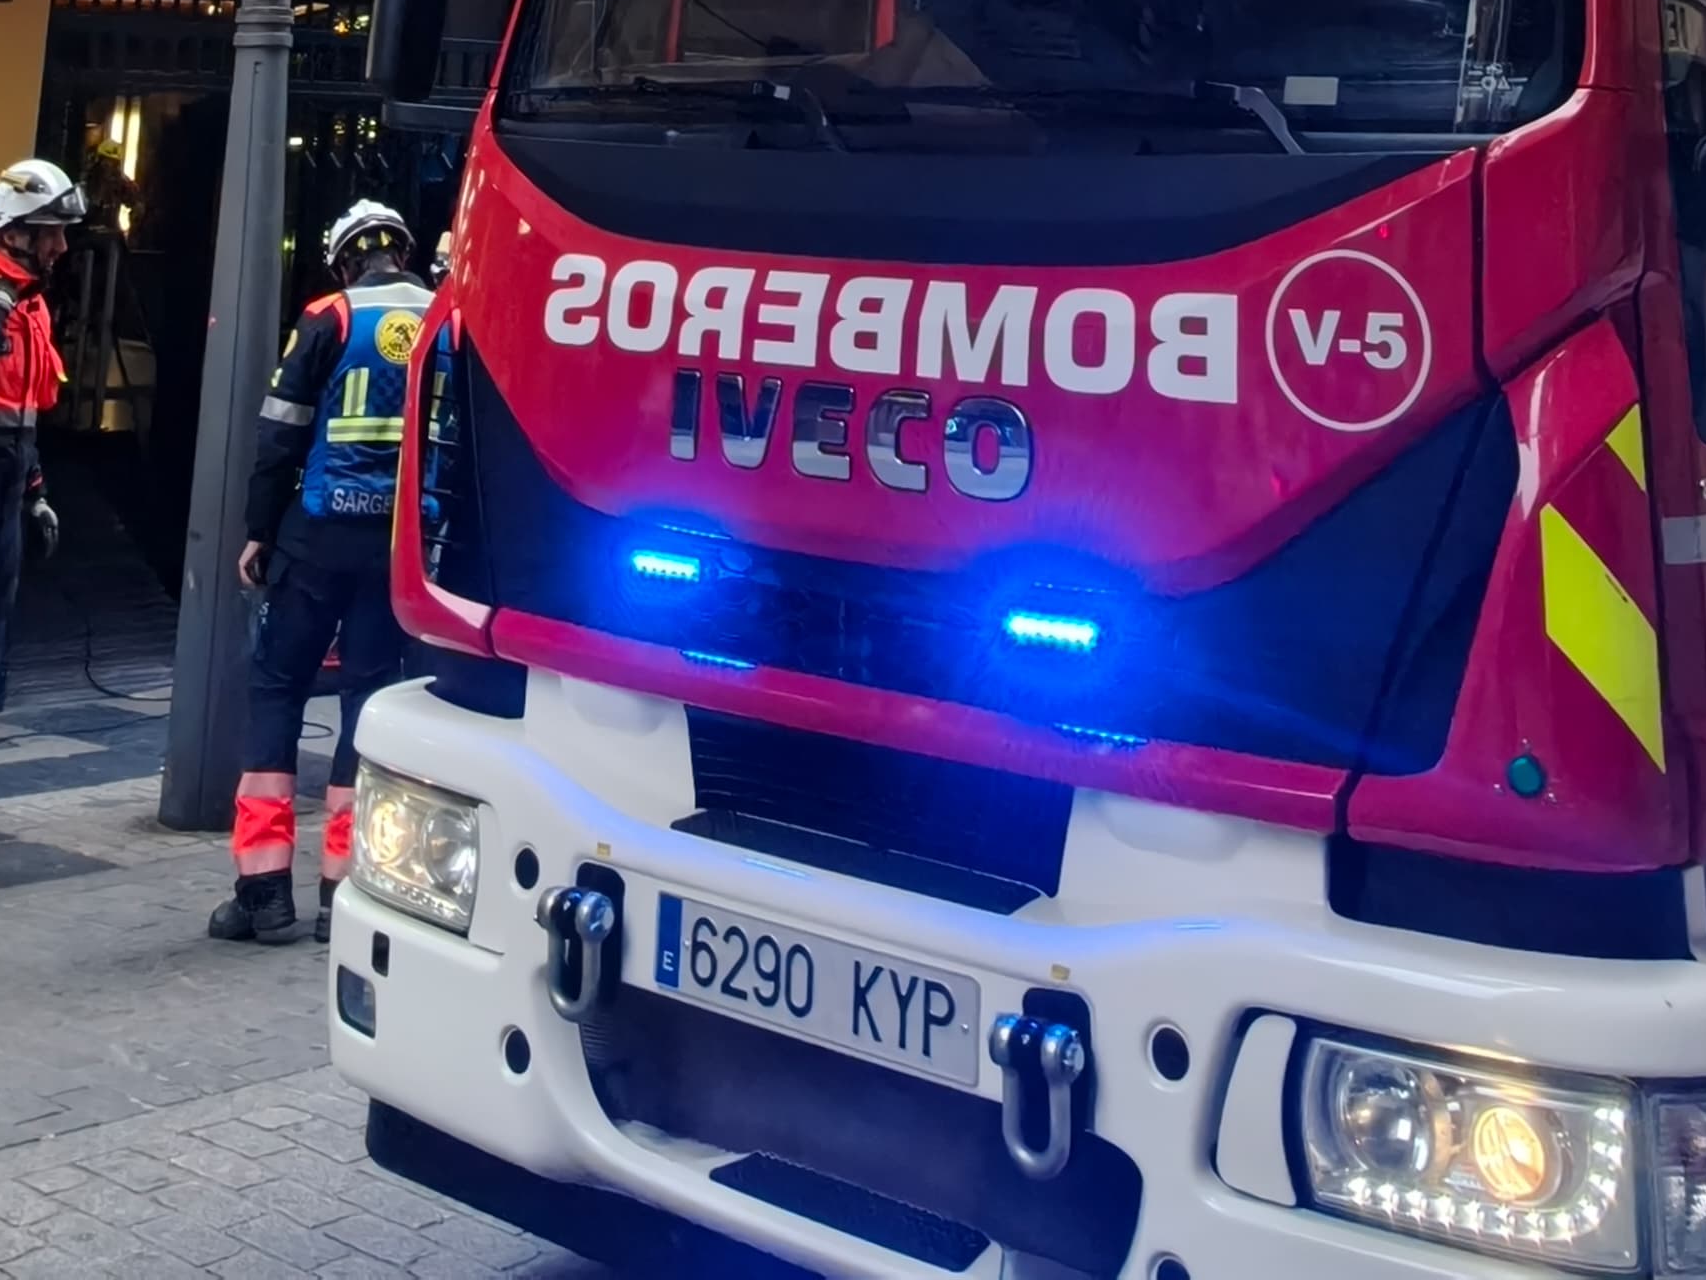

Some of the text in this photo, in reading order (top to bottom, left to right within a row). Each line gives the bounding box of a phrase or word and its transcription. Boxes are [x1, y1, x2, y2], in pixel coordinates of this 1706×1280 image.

[1287, 307, 1410, 370] V-5
[669, 366, 1034, 503] IVECO
[662, 950, 674, 972] E
[689, 916, 957, 1058] 6290 KYP
